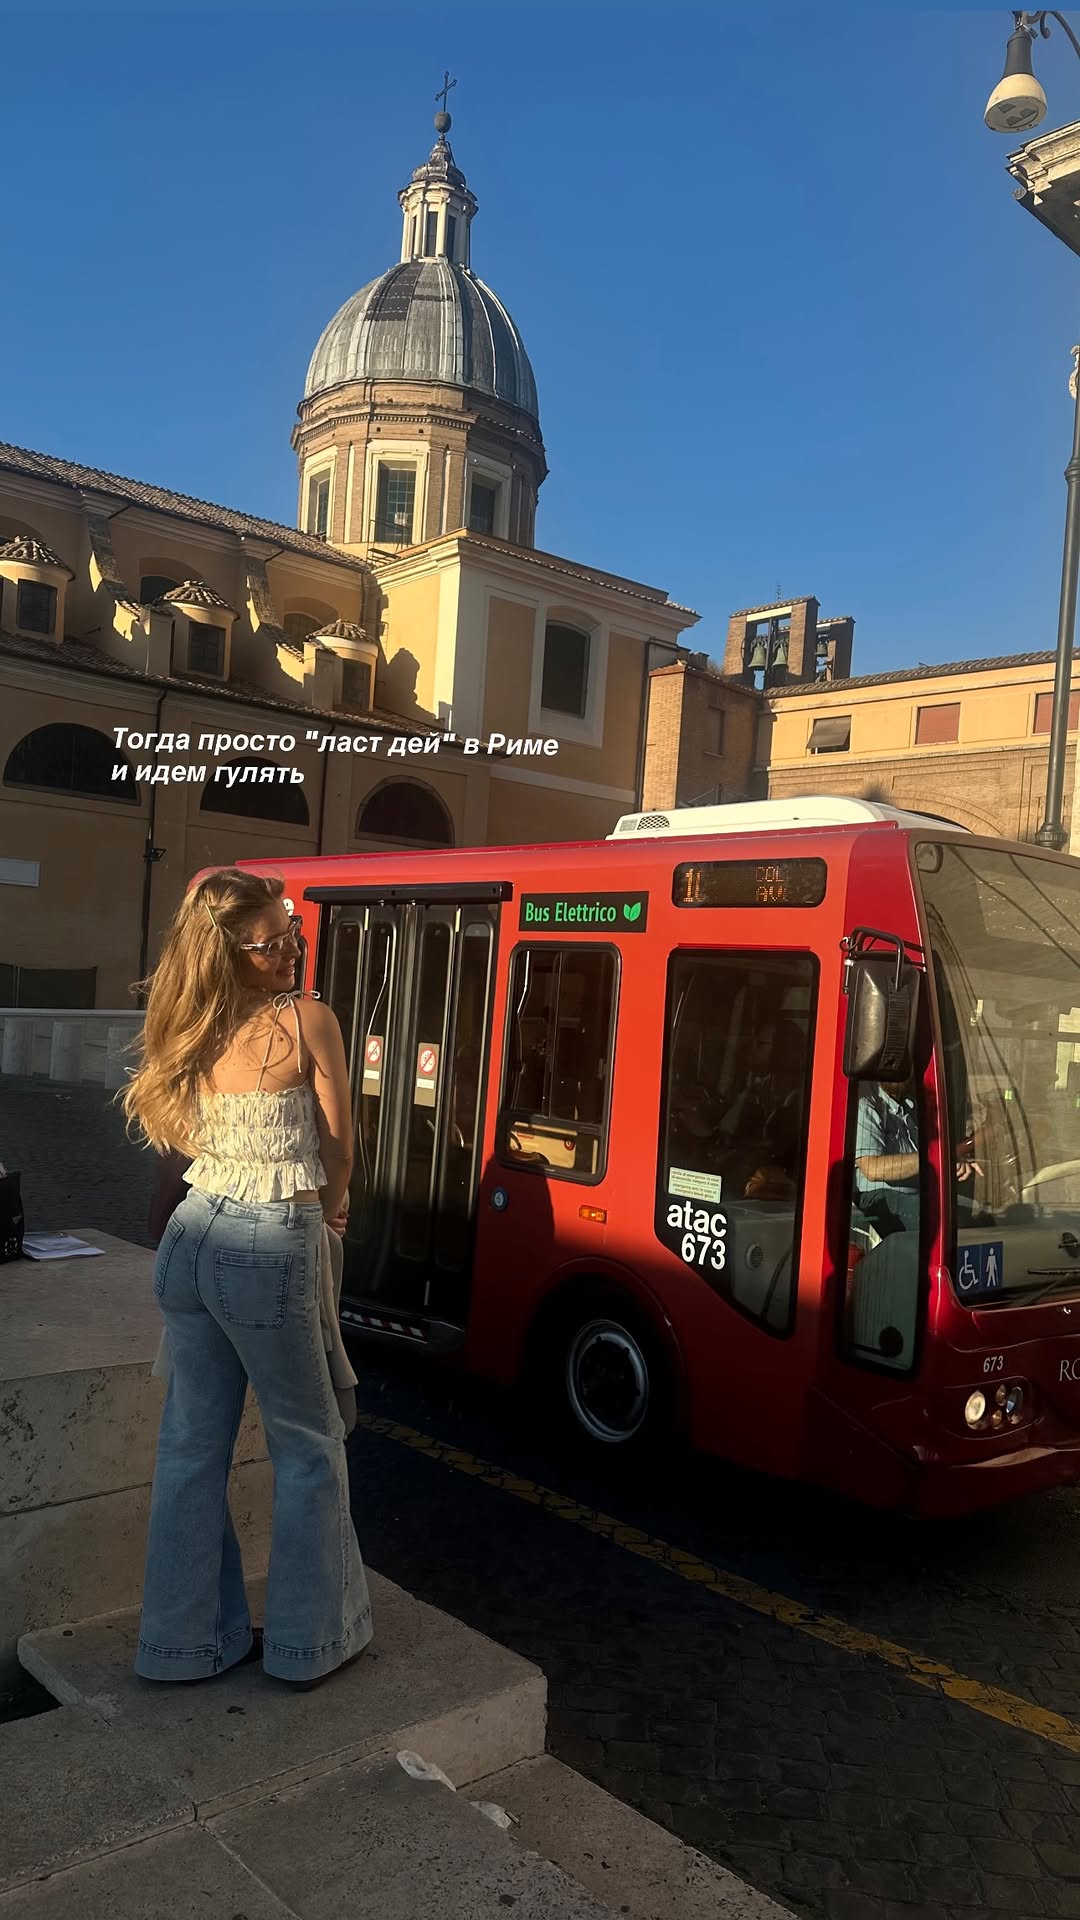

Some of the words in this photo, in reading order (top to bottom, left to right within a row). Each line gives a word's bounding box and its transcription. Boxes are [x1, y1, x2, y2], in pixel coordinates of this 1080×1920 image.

[525, 902, 550, 922] Bus
[555, 902, 617, 922] Elettrico
[666, 1200, 728, 1238] atac
[681, 1232, 726, 1270] 673
[983, 1355, 1004, 1373] 673
